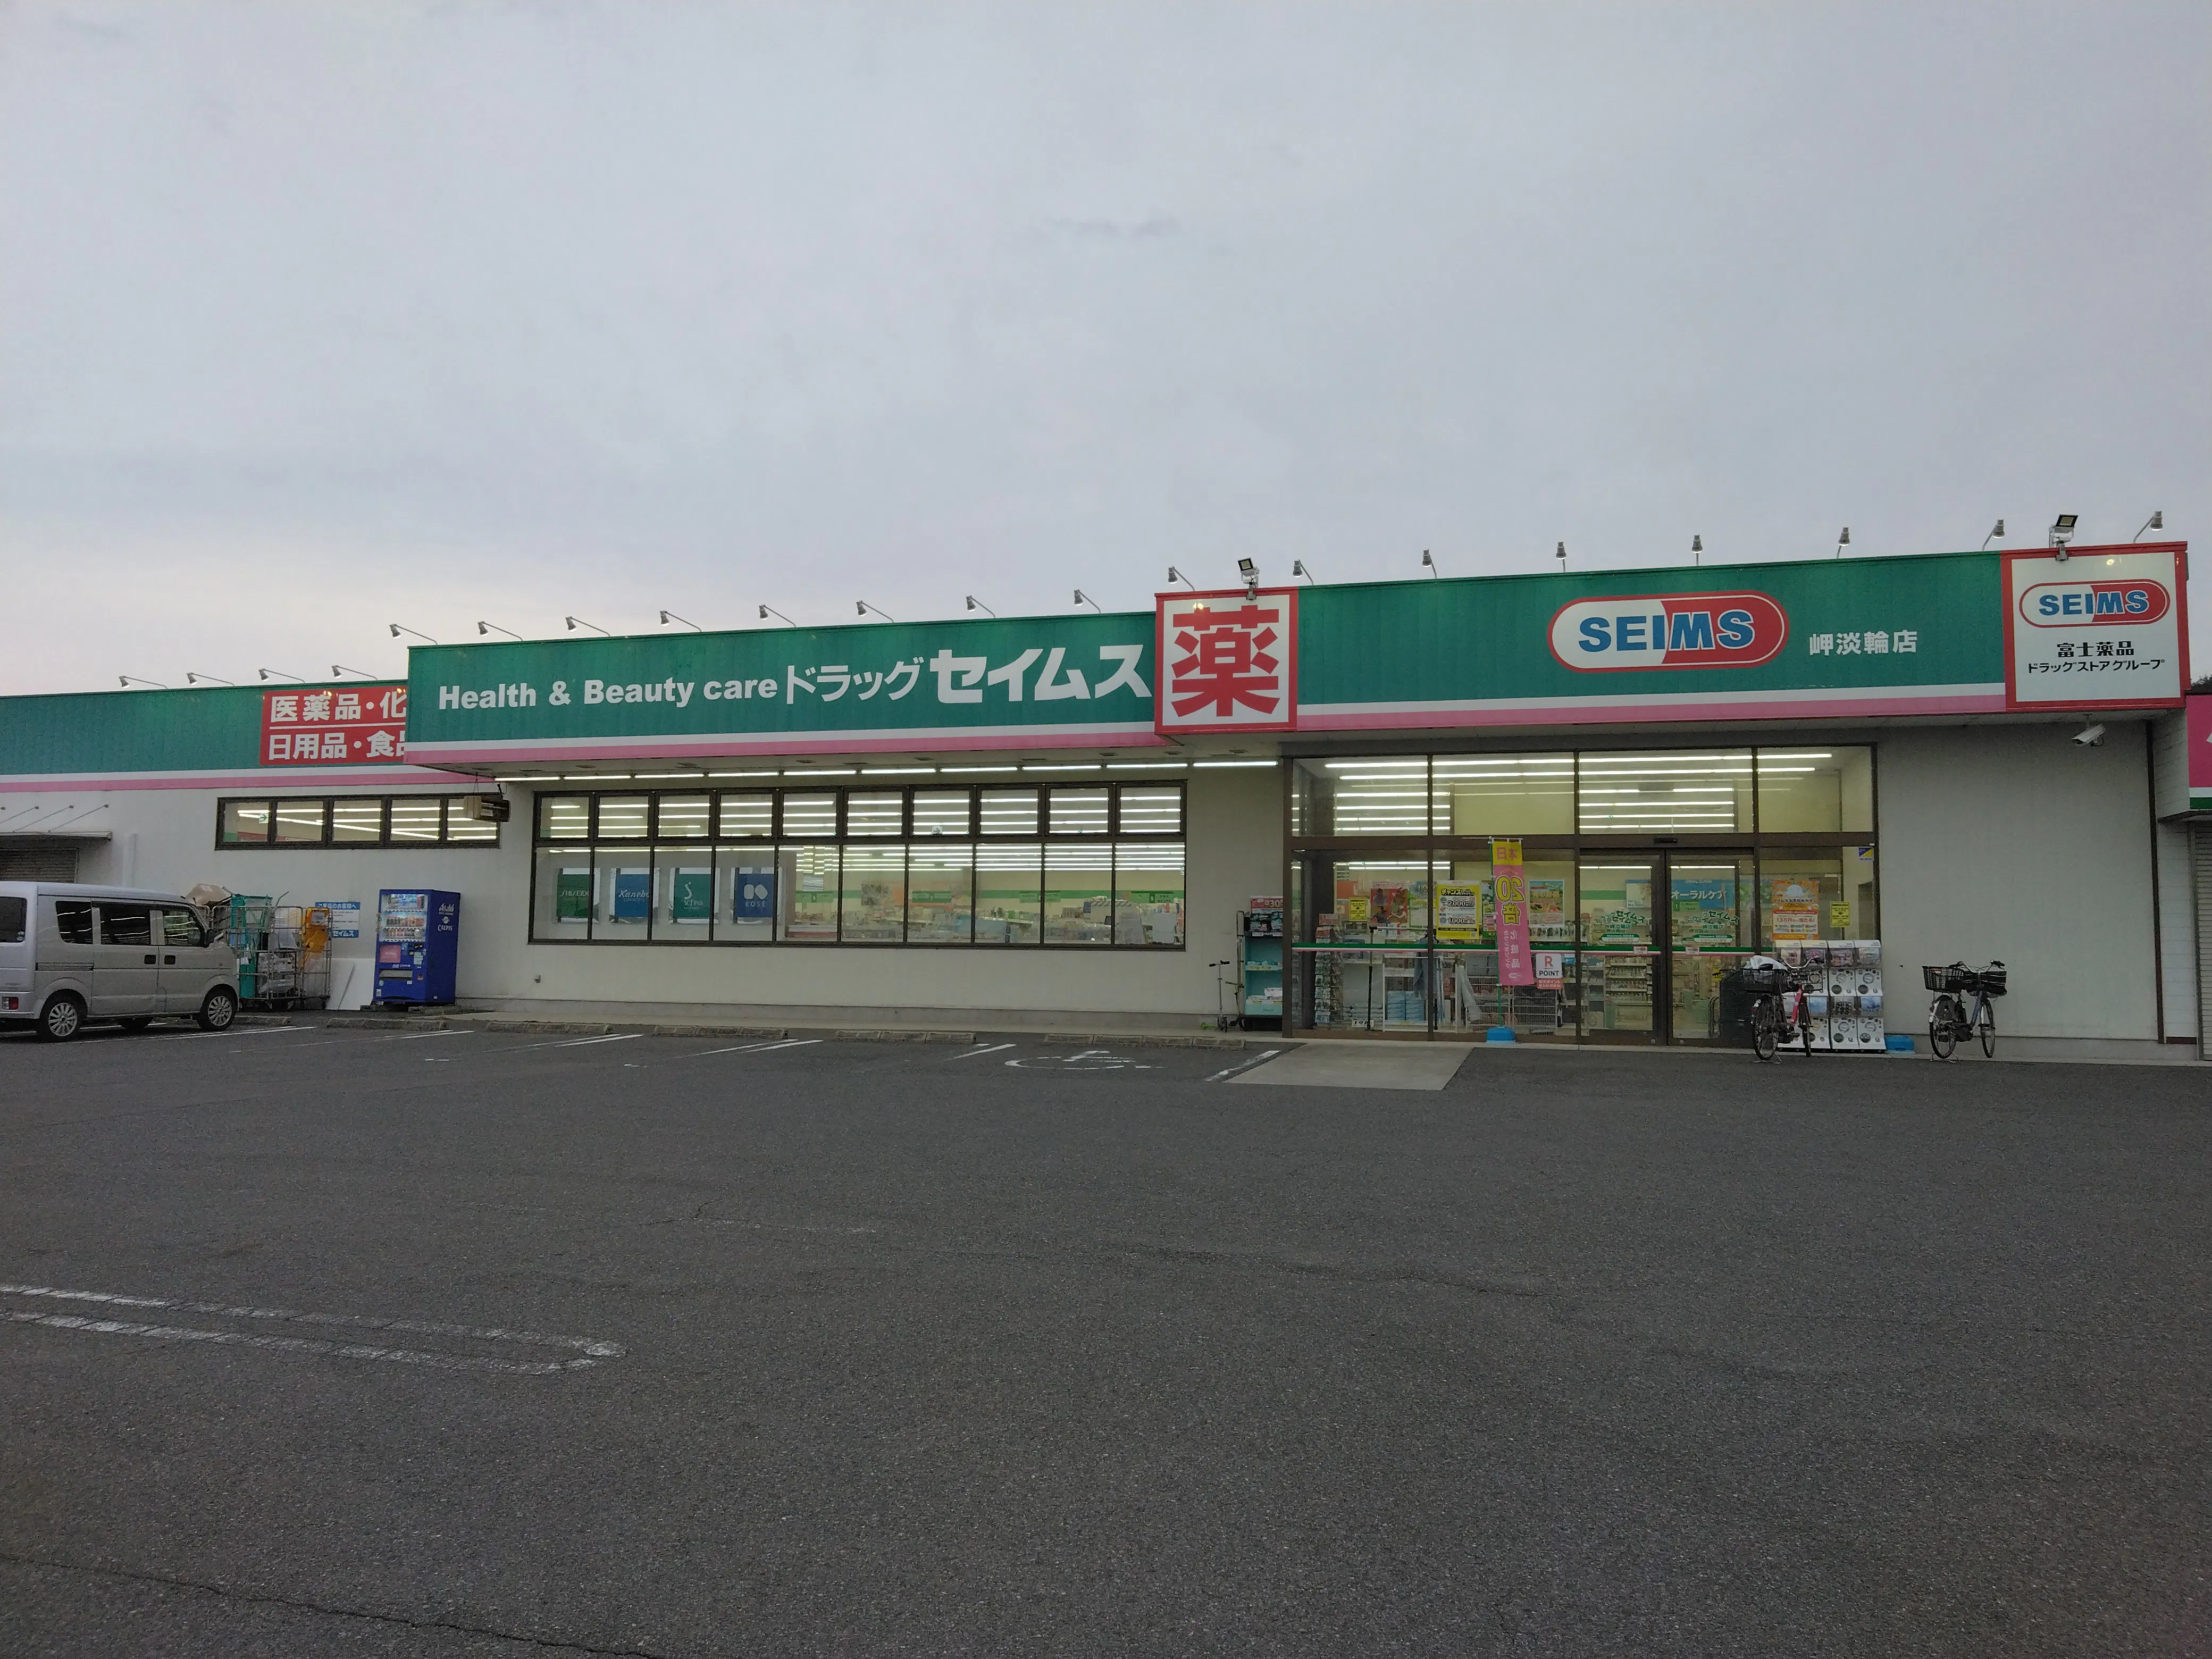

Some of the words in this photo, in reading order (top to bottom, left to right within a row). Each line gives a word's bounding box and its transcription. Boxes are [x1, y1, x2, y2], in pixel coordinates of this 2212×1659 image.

[2039, 590, 2149, 616] SEIMS
[1578, 609, 1755, 652] SEIMS
[1809, 630, 1917, 656] 岬淡輪店
[1170, 605, 1281, 717] 薬
[2057, 641, 2134, 658] 富士薬品
[439, 683, 536, 710] Health
[549, 681, 572, 706] &
[584, 677, 694, 708] Beauty
[703, 678, 778, 700] care
